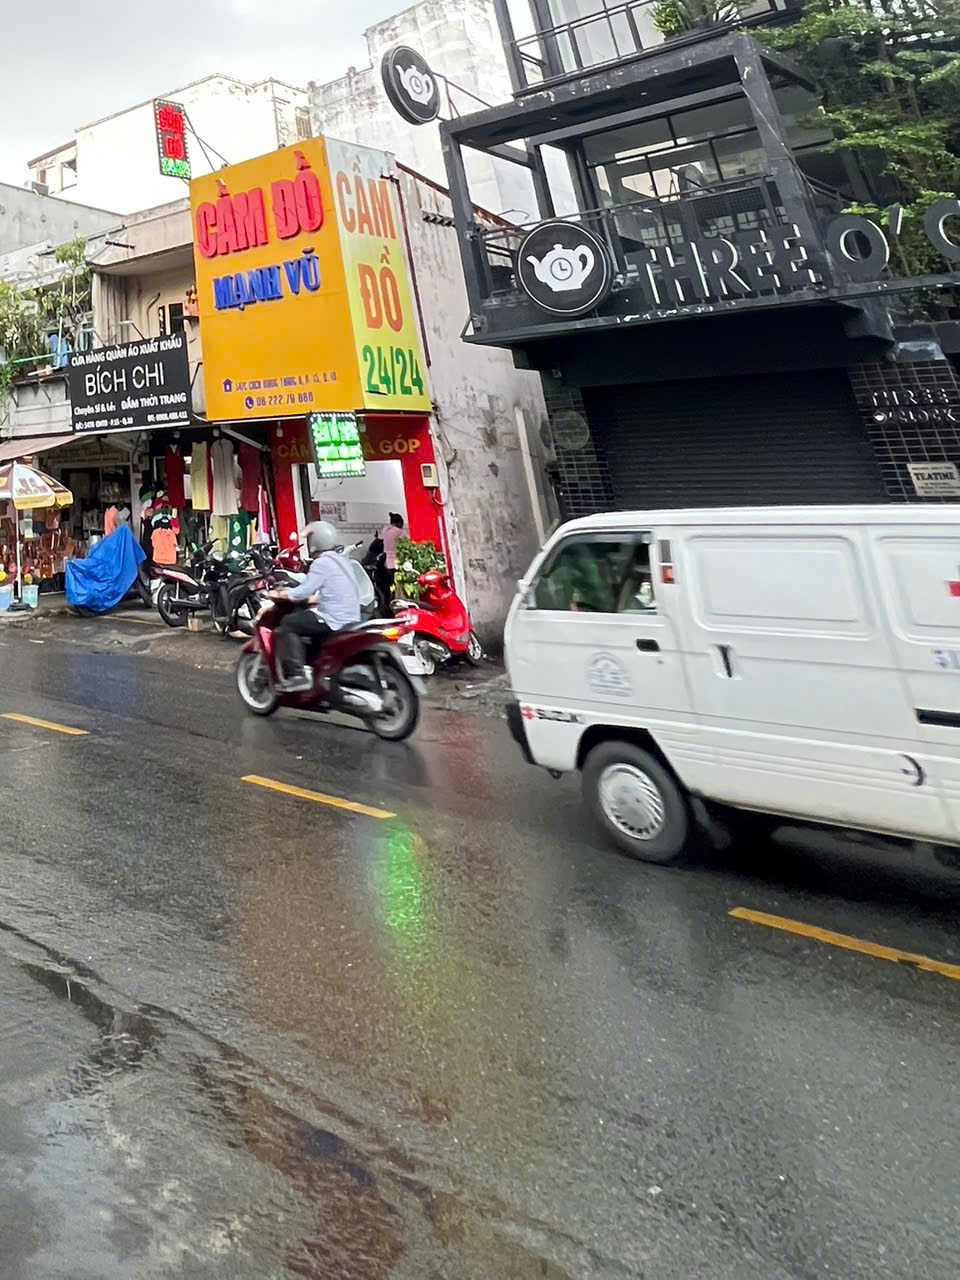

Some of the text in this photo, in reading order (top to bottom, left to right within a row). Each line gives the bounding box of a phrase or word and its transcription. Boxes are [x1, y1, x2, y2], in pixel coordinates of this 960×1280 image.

[195, 150, 325, 259] CẦM ĐỒ
[336, 154, 397, 240] CẦM
[212, 247, 321, 311] MẠNH VŨ
[358, 245, 404, 332] ĐỒ
[626, 223, 821, 307] THREE
[128, 343, 139, 357] ÁO
[362, 345, 424, 396] 24/24
[85, 361, 165, 397] BÍCH CHI
[159, 392, 187, 405] TRANG
[379, 433, 421, 454] GÓP
